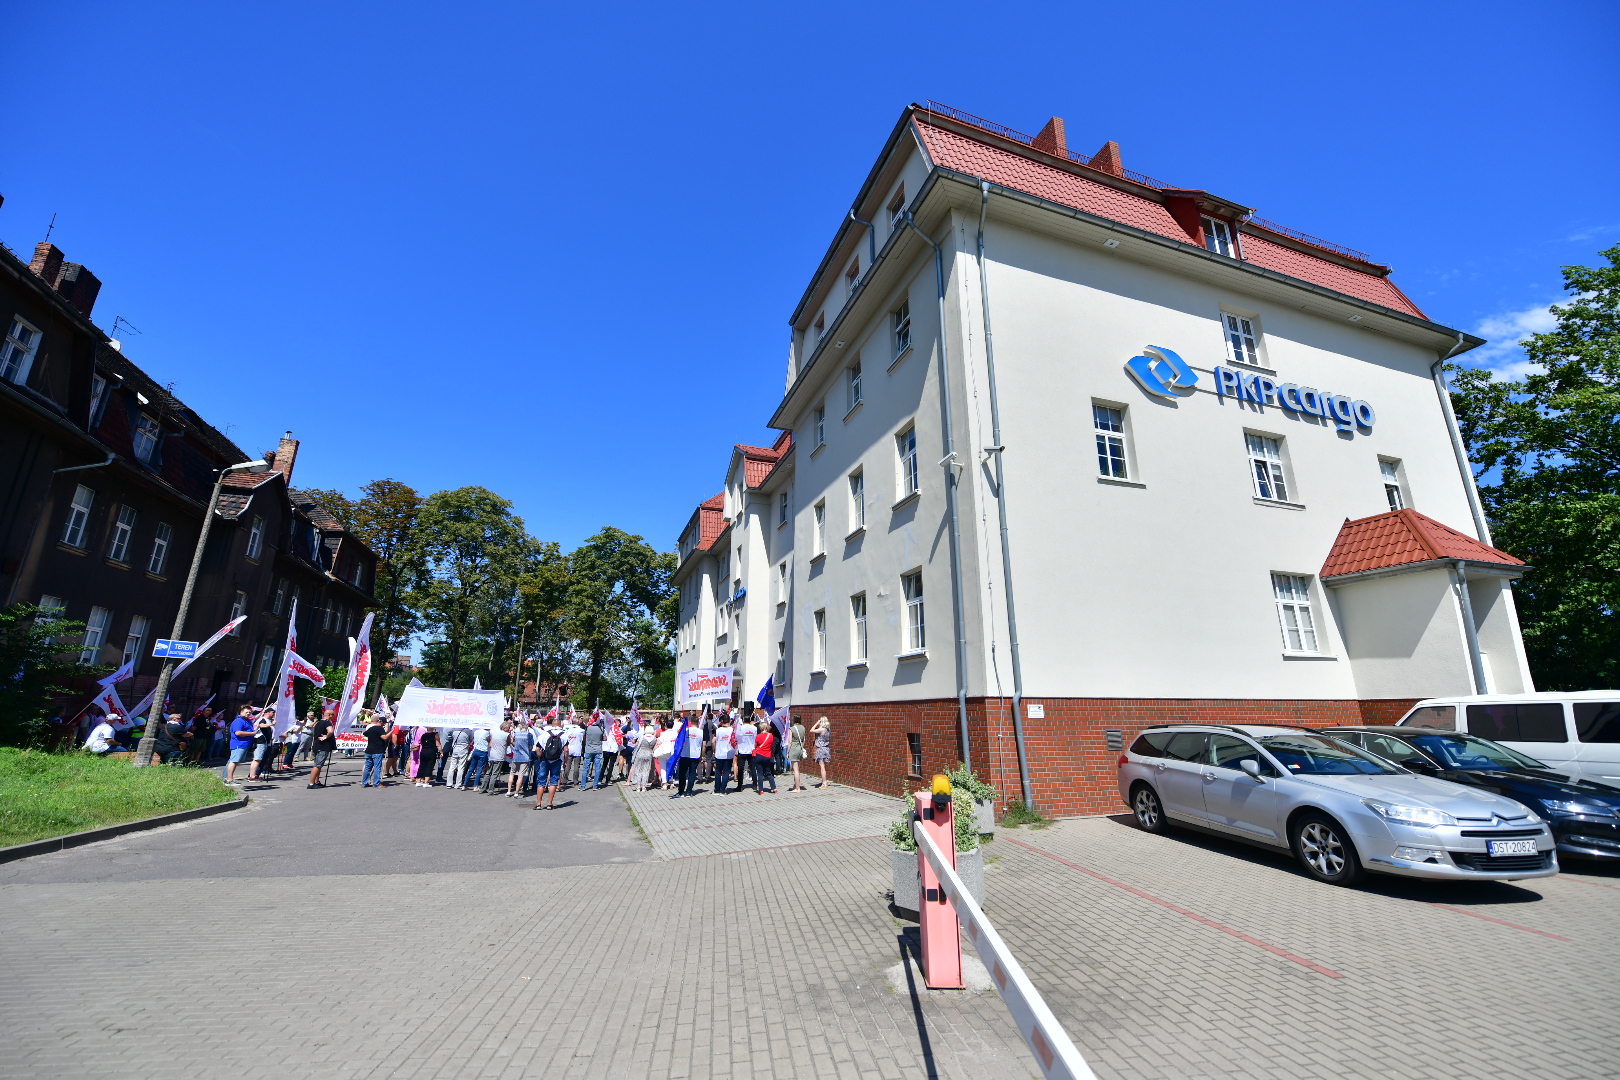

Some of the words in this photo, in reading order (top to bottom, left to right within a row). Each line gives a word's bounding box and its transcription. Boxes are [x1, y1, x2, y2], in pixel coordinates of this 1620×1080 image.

[1214, 366, 1277, 405] PKP
[1277, 383, 1376, 432] cargo
[1492, 842, 1510, 854] DST
[1511, 841, 1537, 853] 20824
